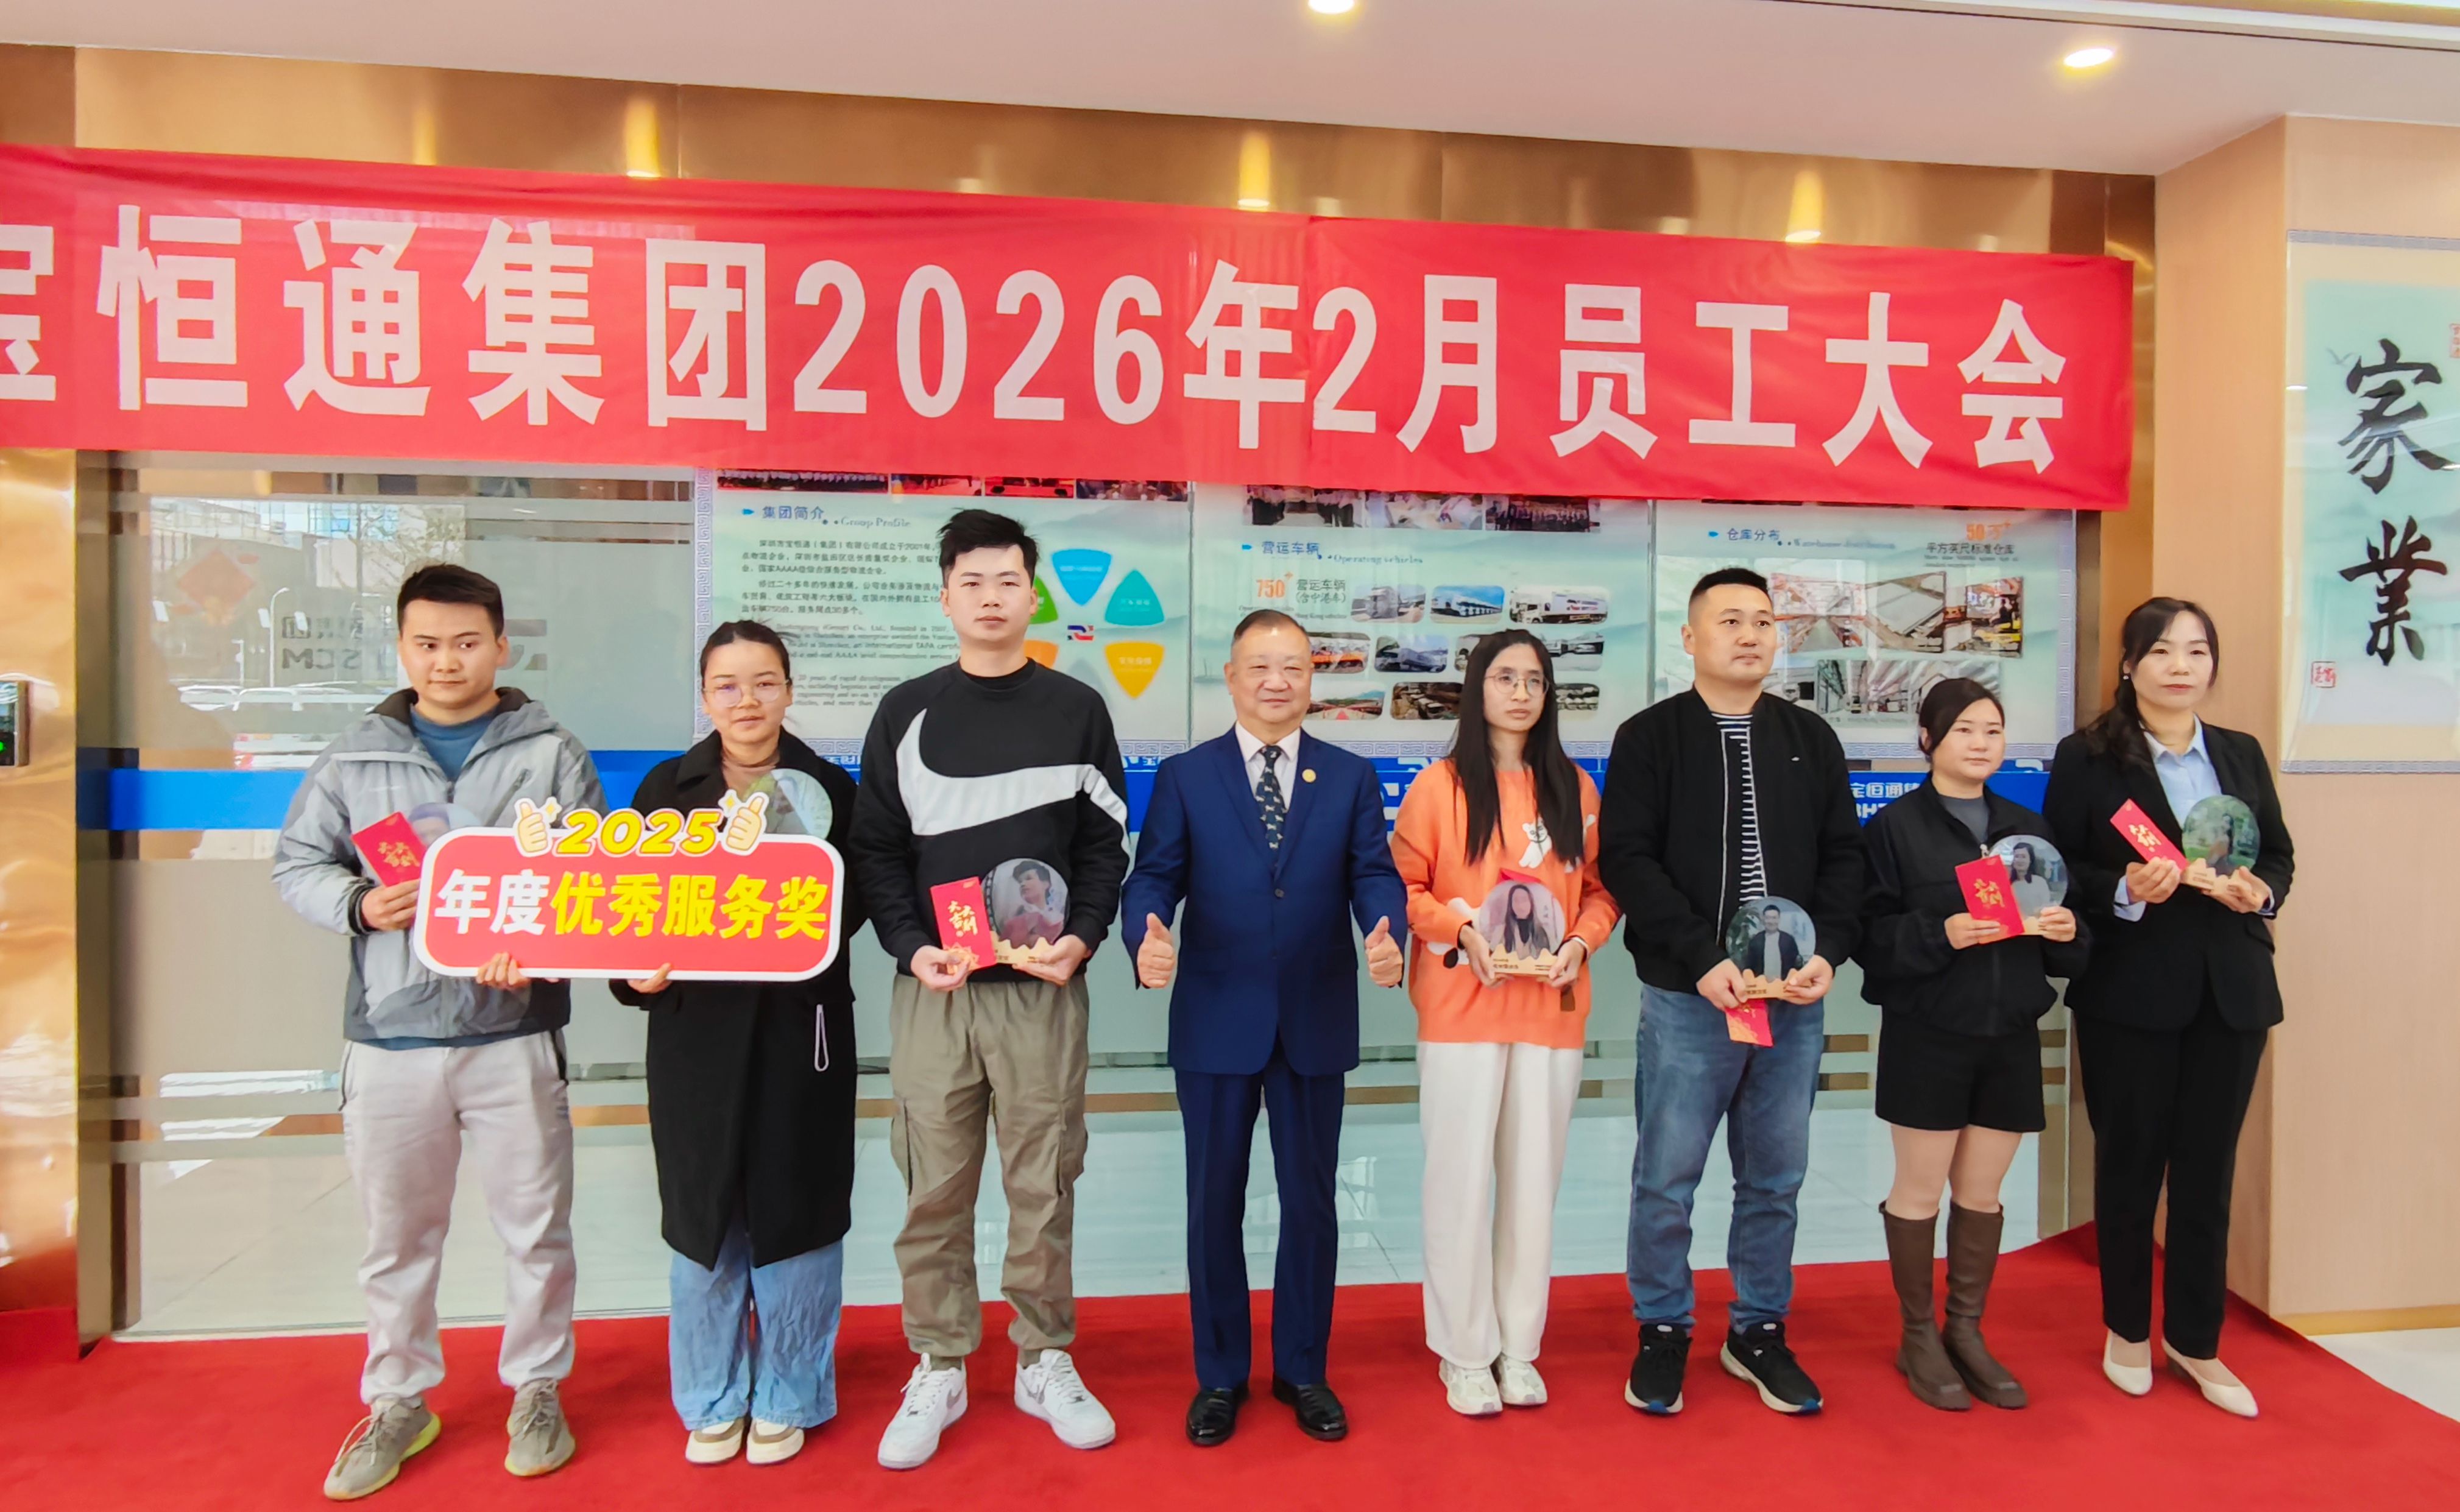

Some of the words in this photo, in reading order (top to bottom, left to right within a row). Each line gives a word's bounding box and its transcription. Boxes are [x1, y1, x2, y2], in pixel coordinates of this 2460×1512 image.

[762, 506, 824, 520] 集团简介
[1727, 528, 1780, 541] 仓库分布
[1262, 541, 1320, 556] 营运车辆
[1296, 579, 1346, 592] 营运车辆
[554, 809, 724, 855] 2025
[433, 868, 829, 941] 年度优秀服务奖
